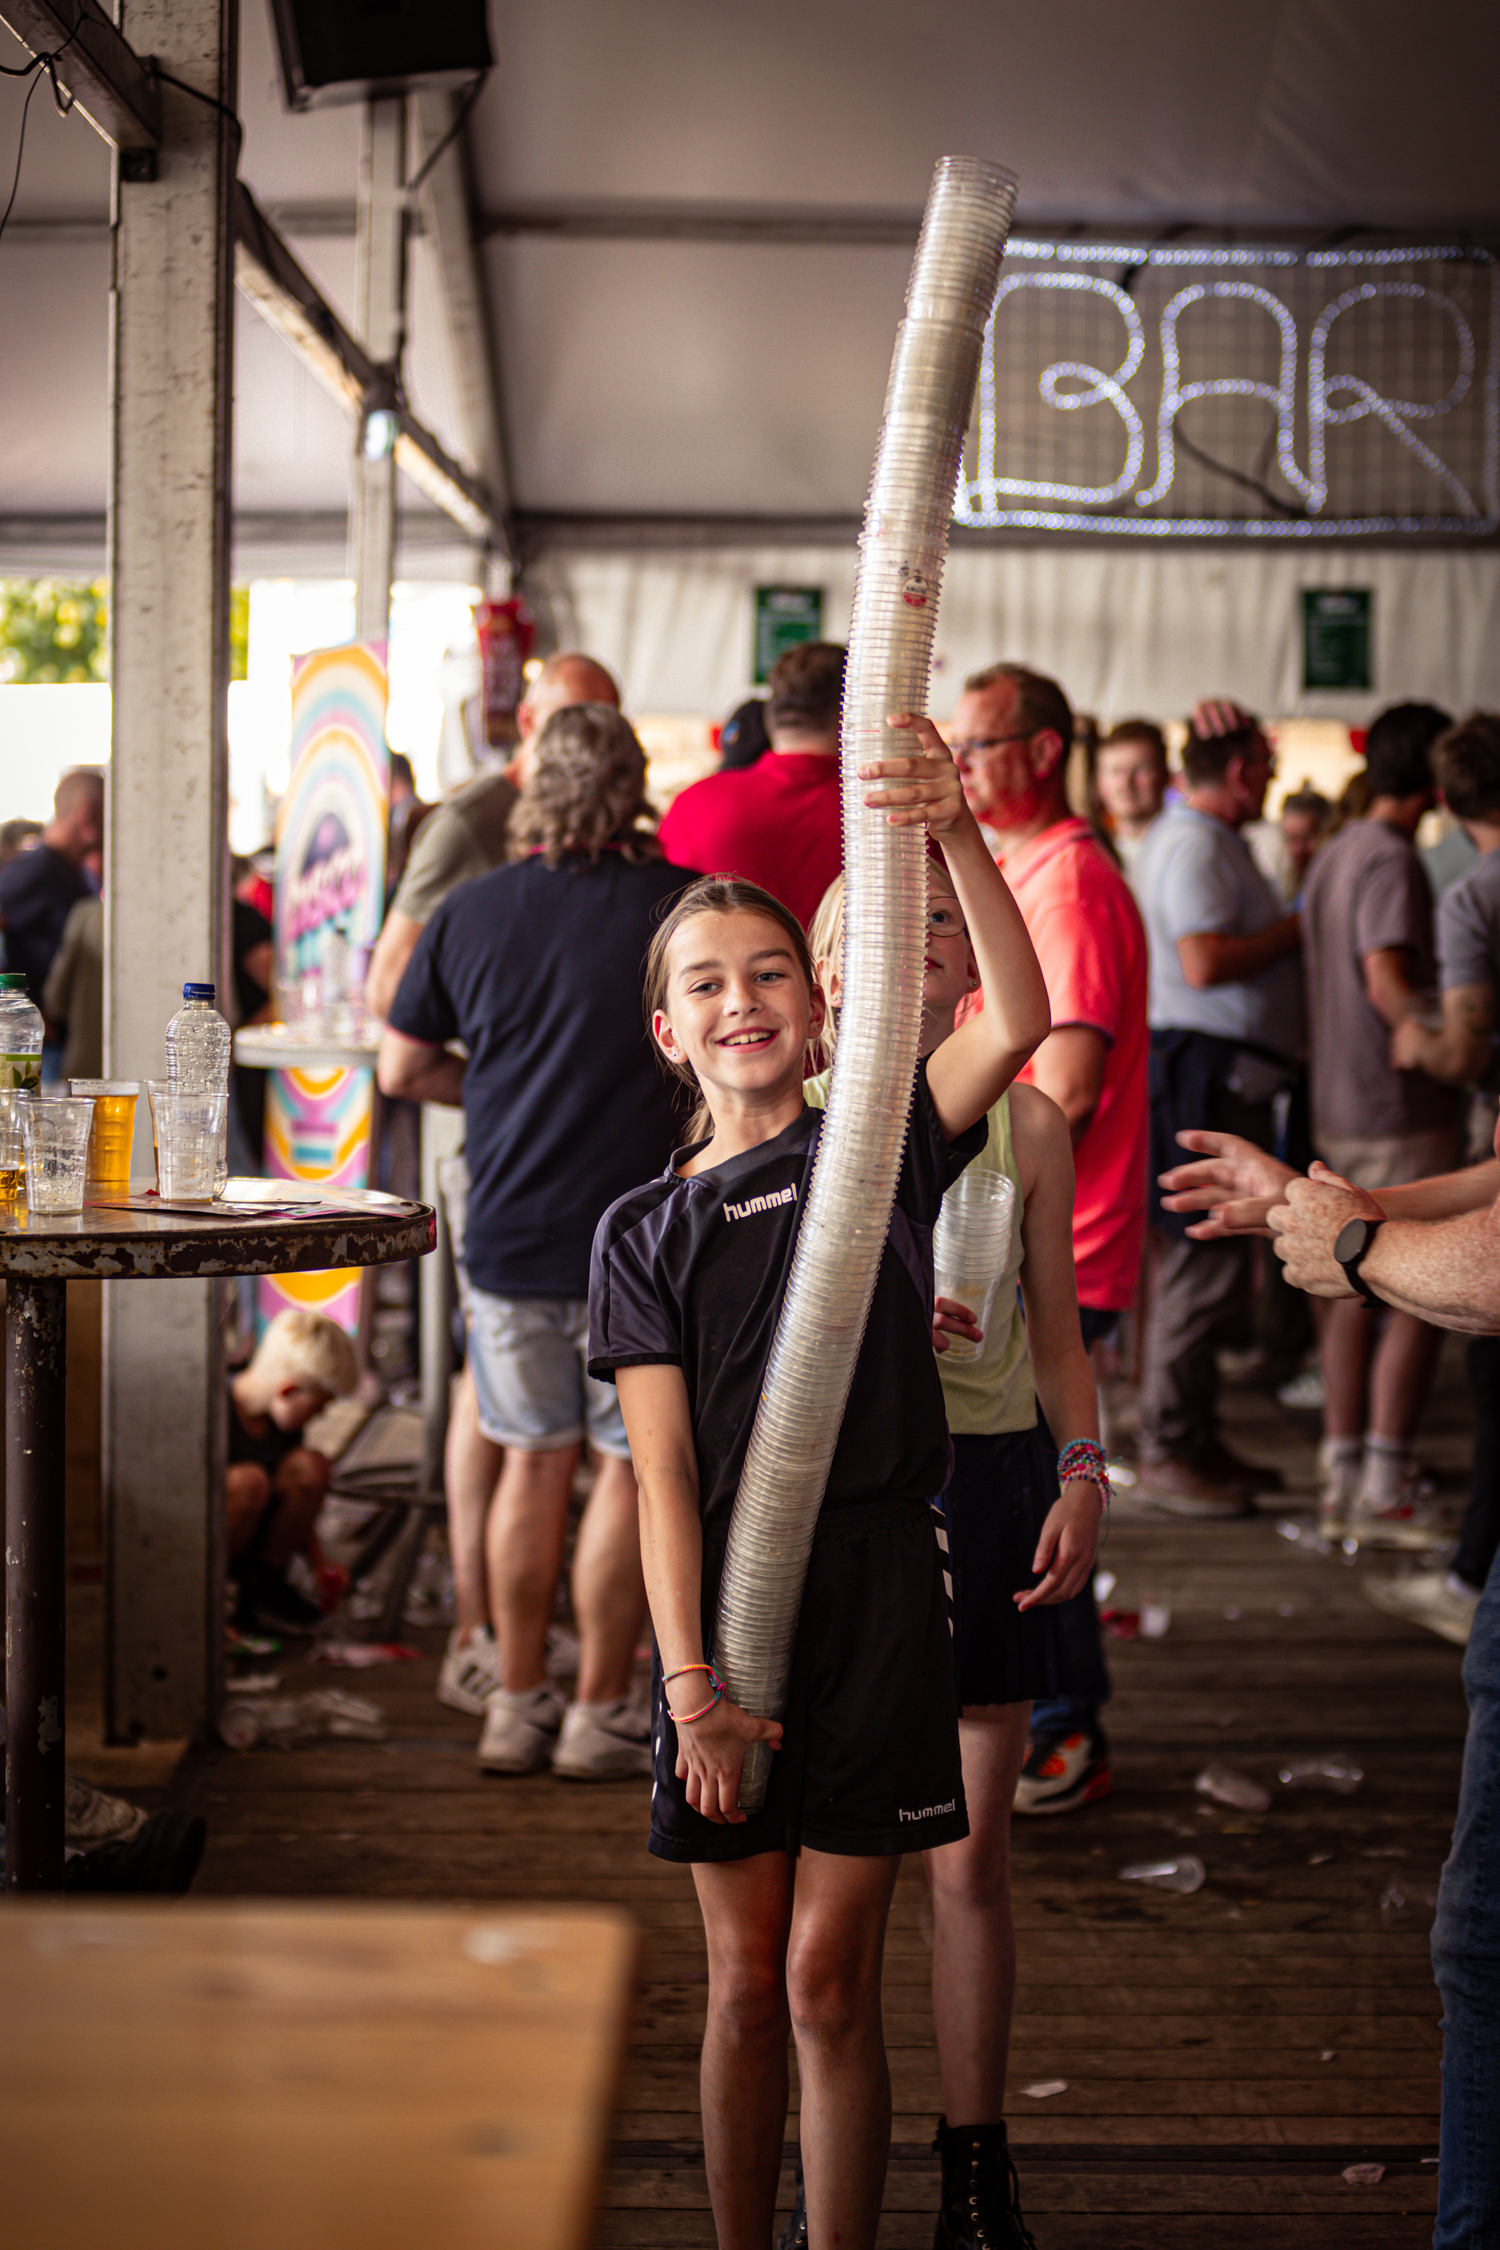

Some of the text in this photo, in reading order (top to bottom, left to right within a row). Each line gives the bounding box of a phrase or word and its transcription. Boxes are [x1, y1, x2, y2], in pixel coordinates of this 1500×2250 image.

[964, 271, 1481, 520] BAR
[722, 1182, 798, 1222] hummel
[898, 1798, 956, 1822] hummel
